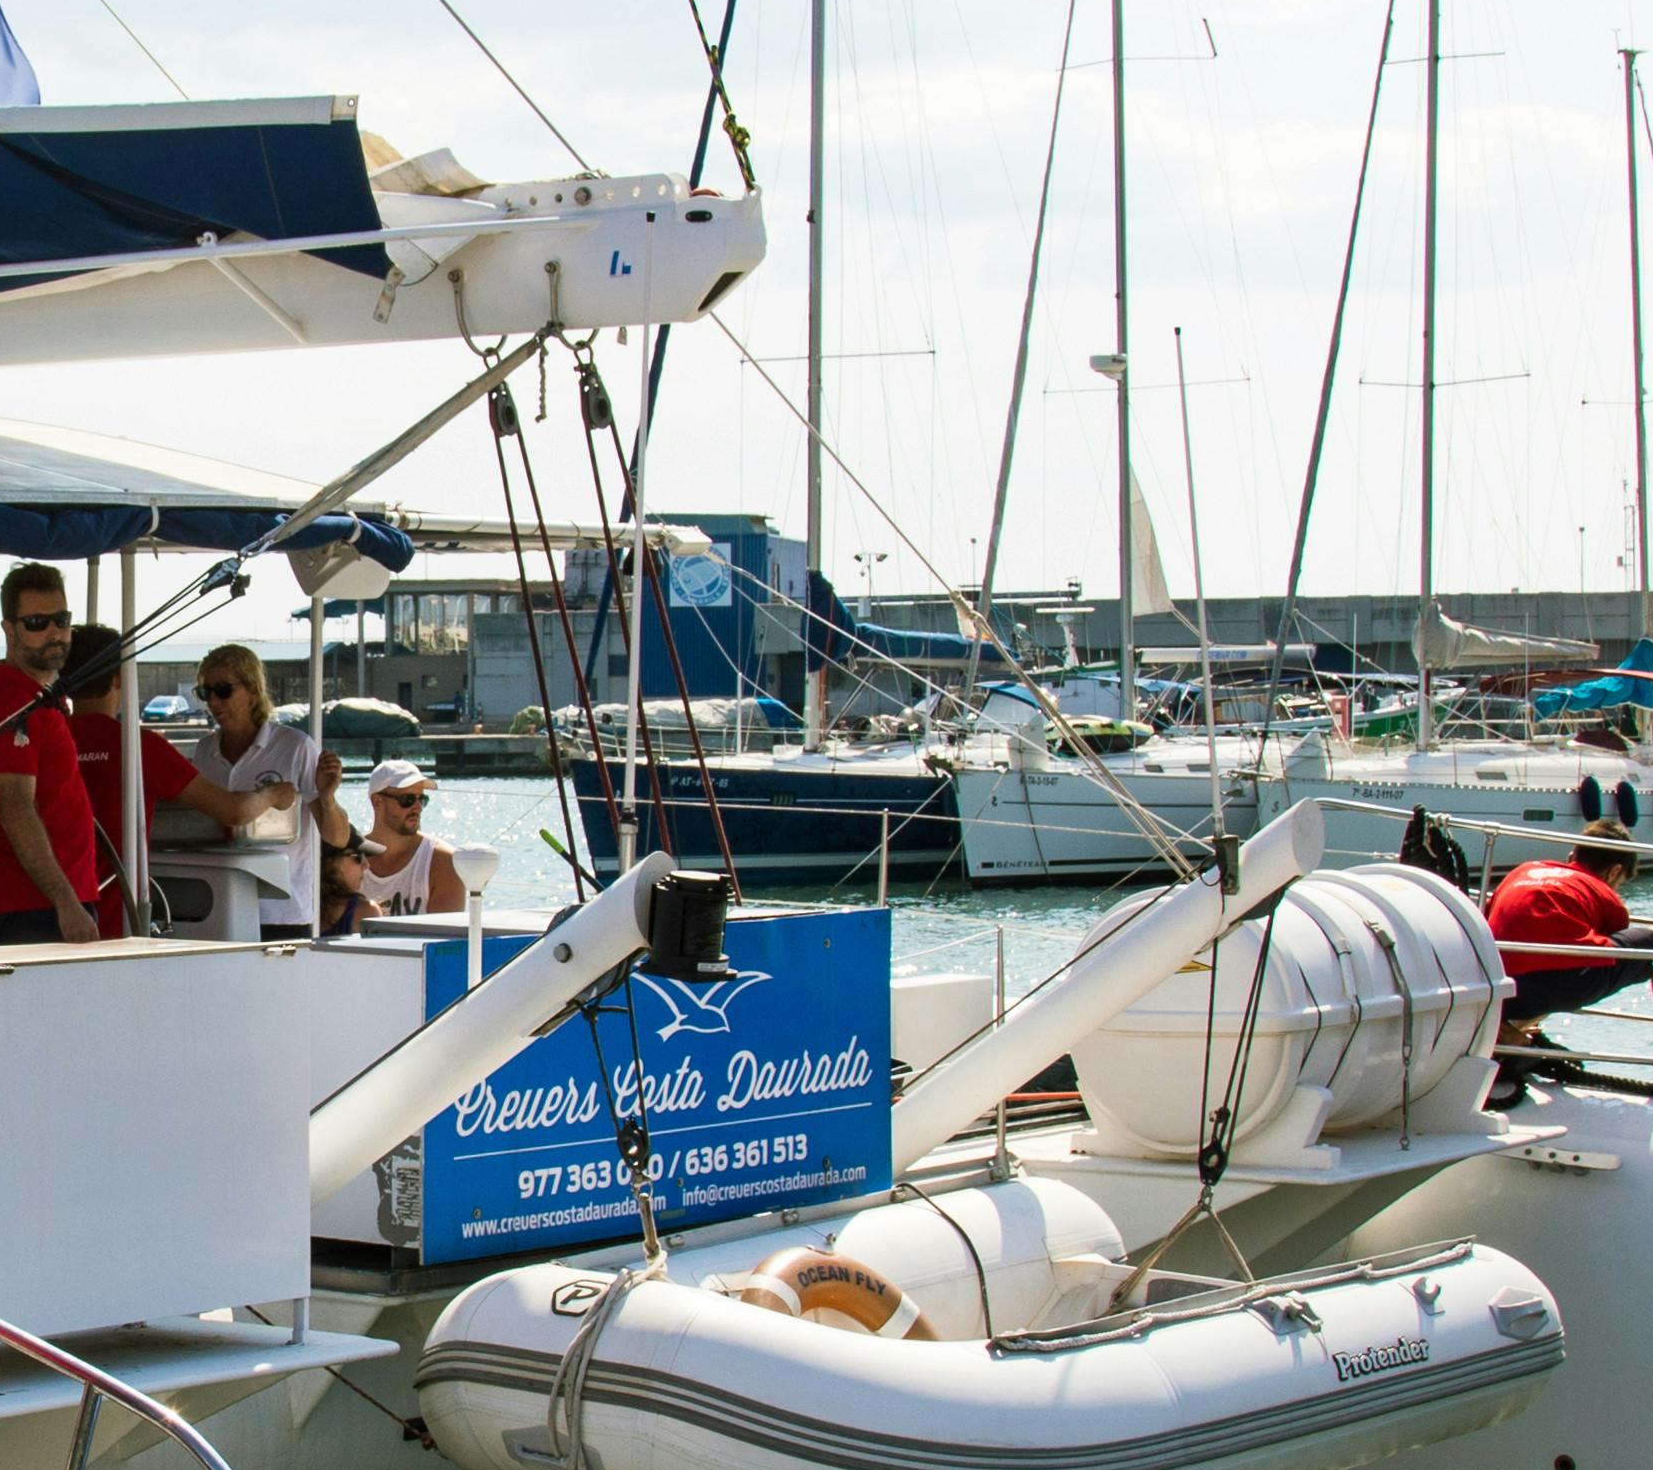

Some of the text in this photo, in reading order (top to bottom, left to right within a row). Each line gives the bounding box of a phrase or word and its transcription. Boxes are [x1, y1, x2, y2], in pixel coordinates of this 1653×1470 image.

[455, 1034, 874, 1137] Creuers Costa Daurada
[518, 1133, 809, 1199] 977 363 00 / 636 361 513
[462, 1162, 867, 1239] www.creuerscostadaurada.om info@creuerscostadaurada.com
[797, 1265, 887, 1296] OCEAN FLY
[1332, 1335, 1430, 1383] Protender
